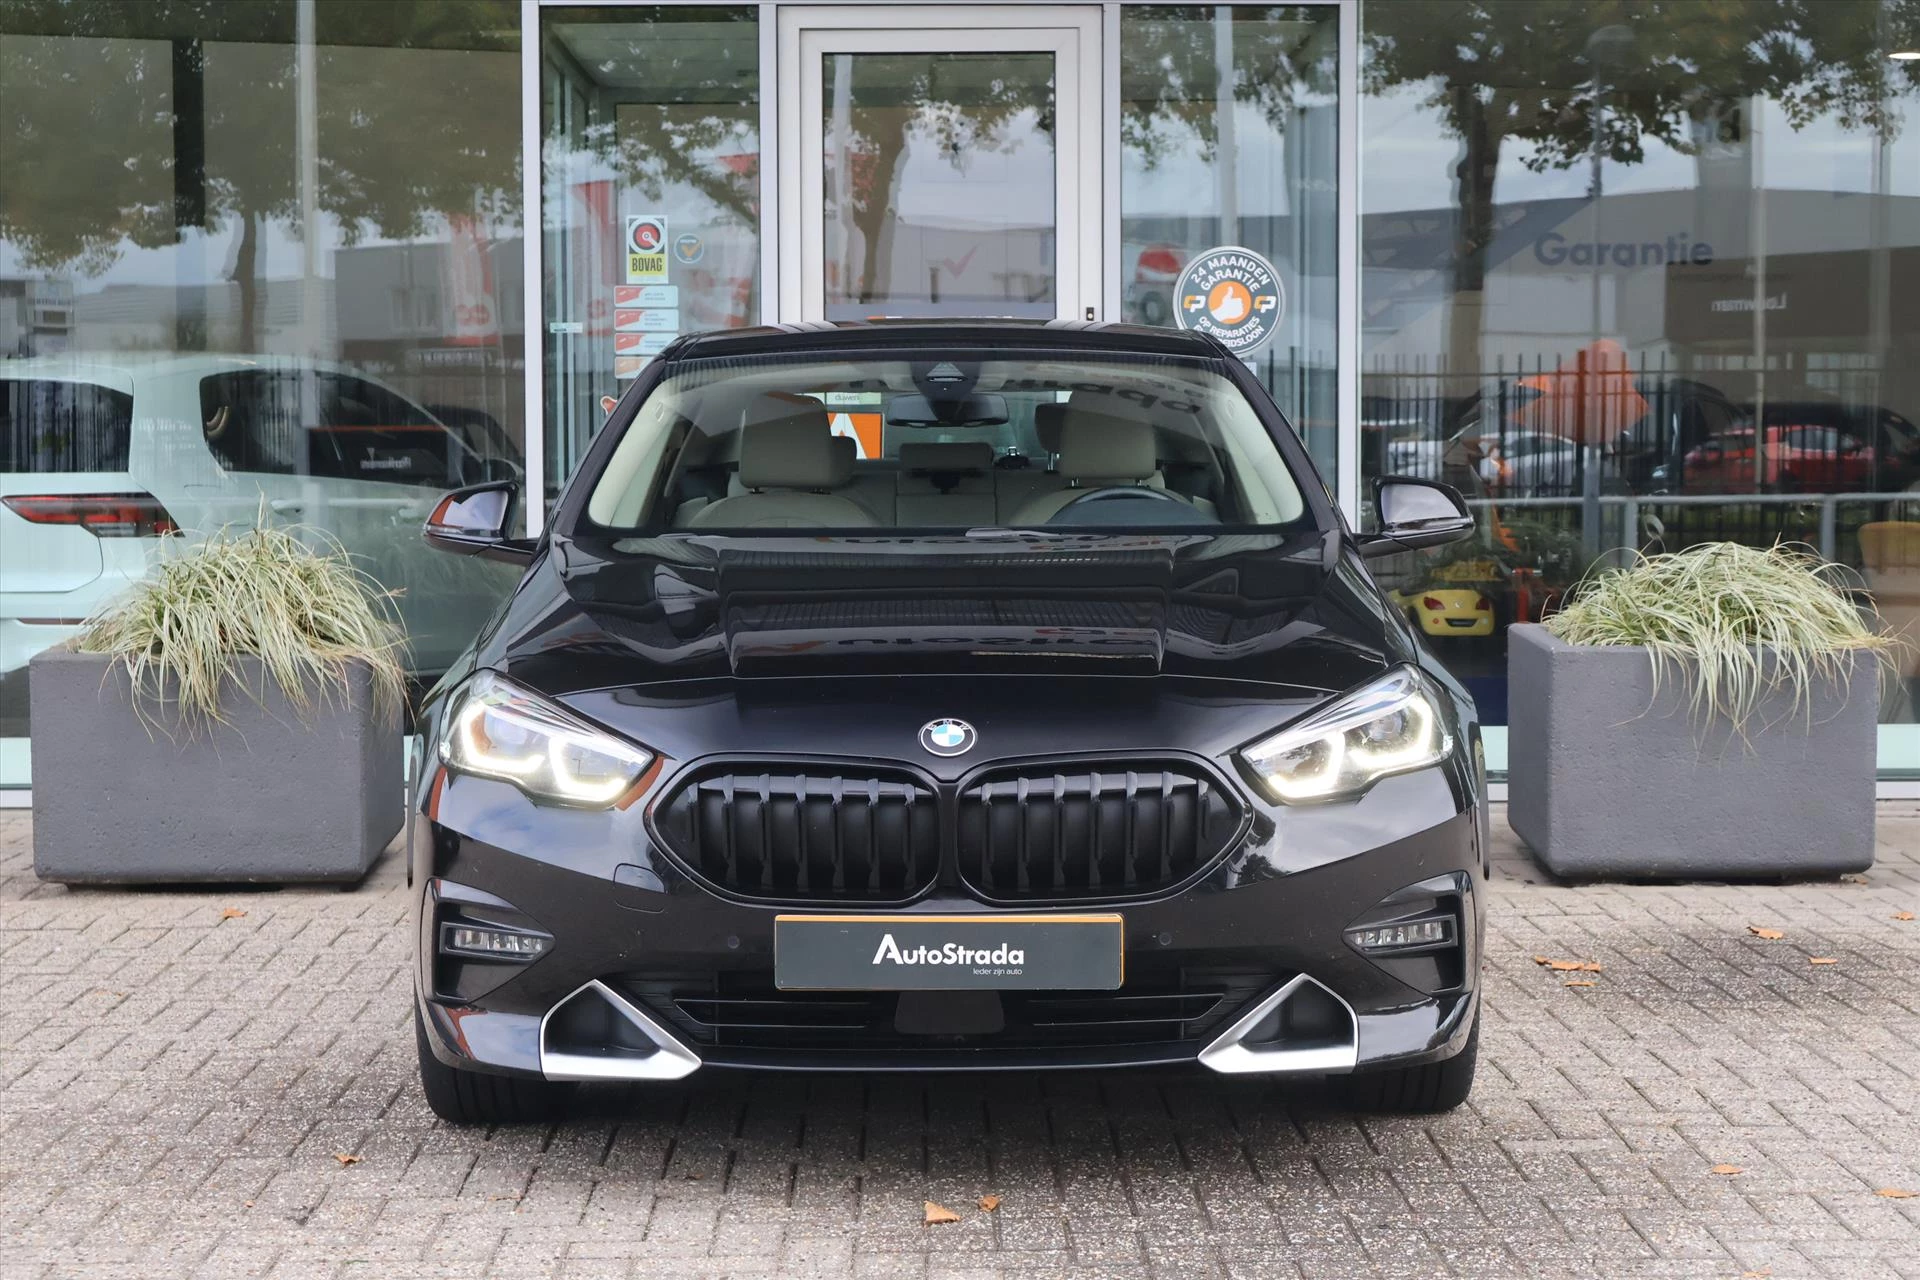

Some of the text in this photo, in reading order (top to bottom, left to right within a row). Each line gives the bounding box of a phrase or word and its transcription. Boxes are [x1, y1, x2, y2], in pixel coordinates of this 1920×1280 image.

[1534, 232, 1713, 267] Garantie
[631, 257, 663, 272] BOVAG
[1190, 256, 1270, 285] 24 MAANDEN
[1200, 268, 1260, 292] GARANTIE
[1199, 316, 1260, 338] OP REPARATIES
[926, 719, 970, 731] BMW
[872, 933, 1025, 965] AutoStrada
[993, 967, 1005, 976] zijn
